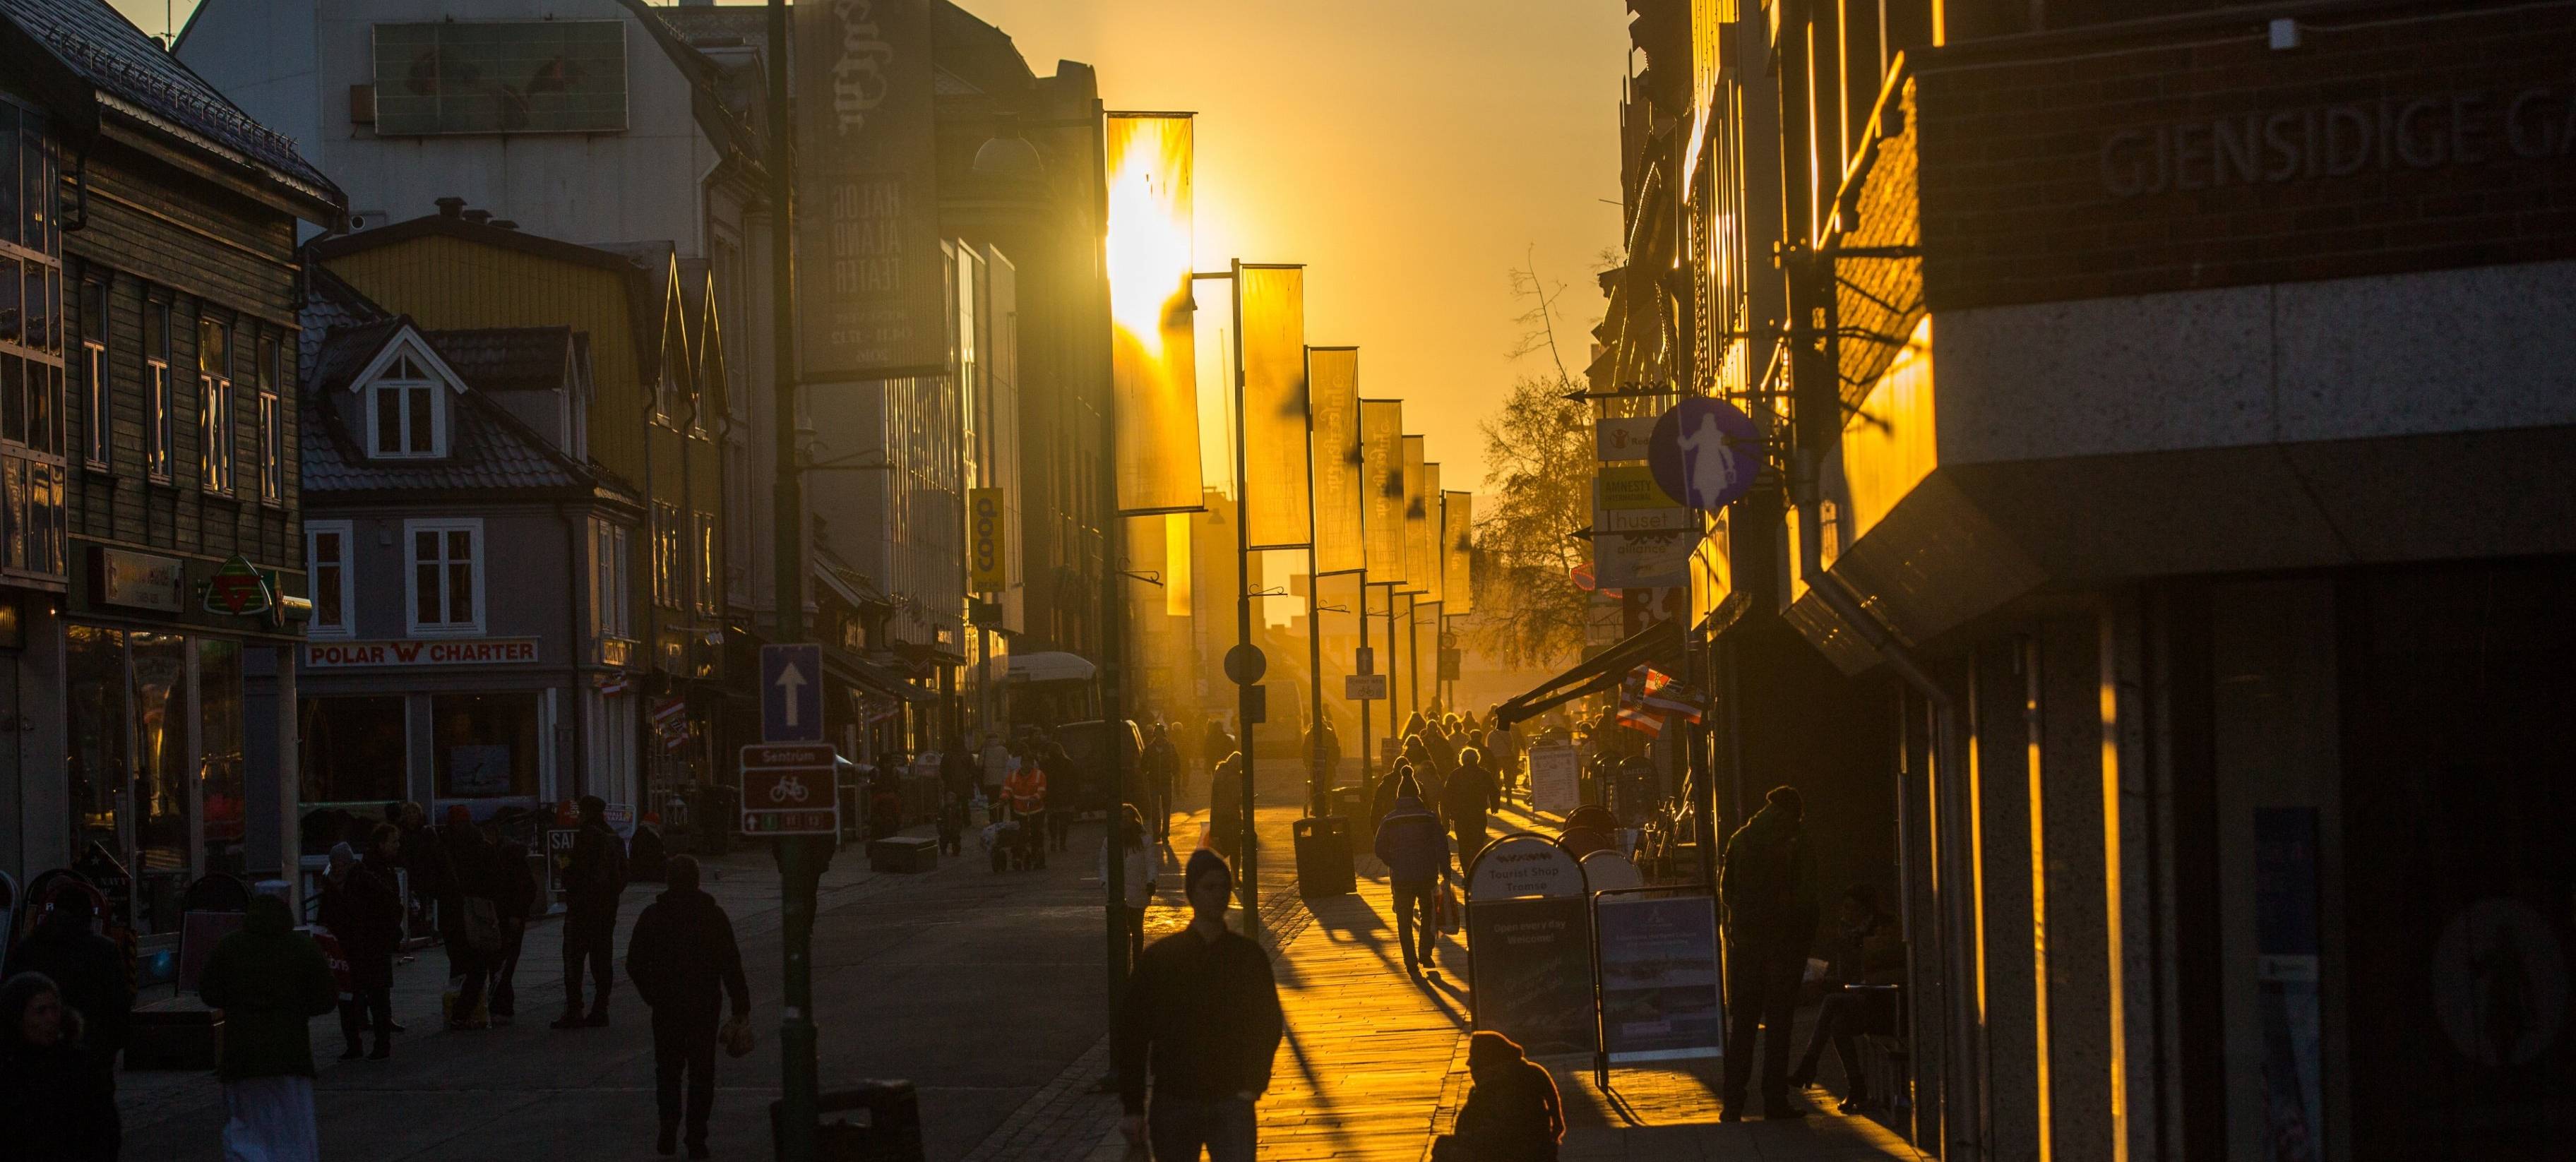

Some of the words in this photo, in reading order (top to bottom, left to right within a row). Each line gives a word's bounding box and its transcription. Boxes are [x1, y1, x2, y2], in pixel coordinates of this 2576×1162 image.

[2099, 93, 2486, 198] GJENSIDIGE
[1605, 480, 1652, 493] AMNESTY
[1616, 513, 1668, 528] huset
[976, 497, 997, 573] coop
[1617, 544, 1666, 554] alliance
[977, 578, 999, 589] prix
[311, 647, 384, 664] POLAR
[429, 644, 533, 661] CHARTER
[763, 750, 815, 762] Sentrum
[1489, 869, 1527, 880] Tourist
[1532, 867, 1558, 877] Shop
[1493, 923, 1518, 934] Open
[1520, 922, 1546, 931] every
[1548, 920, 1566, 930] day
[1507, 933, 1555, 945] Welcome!
